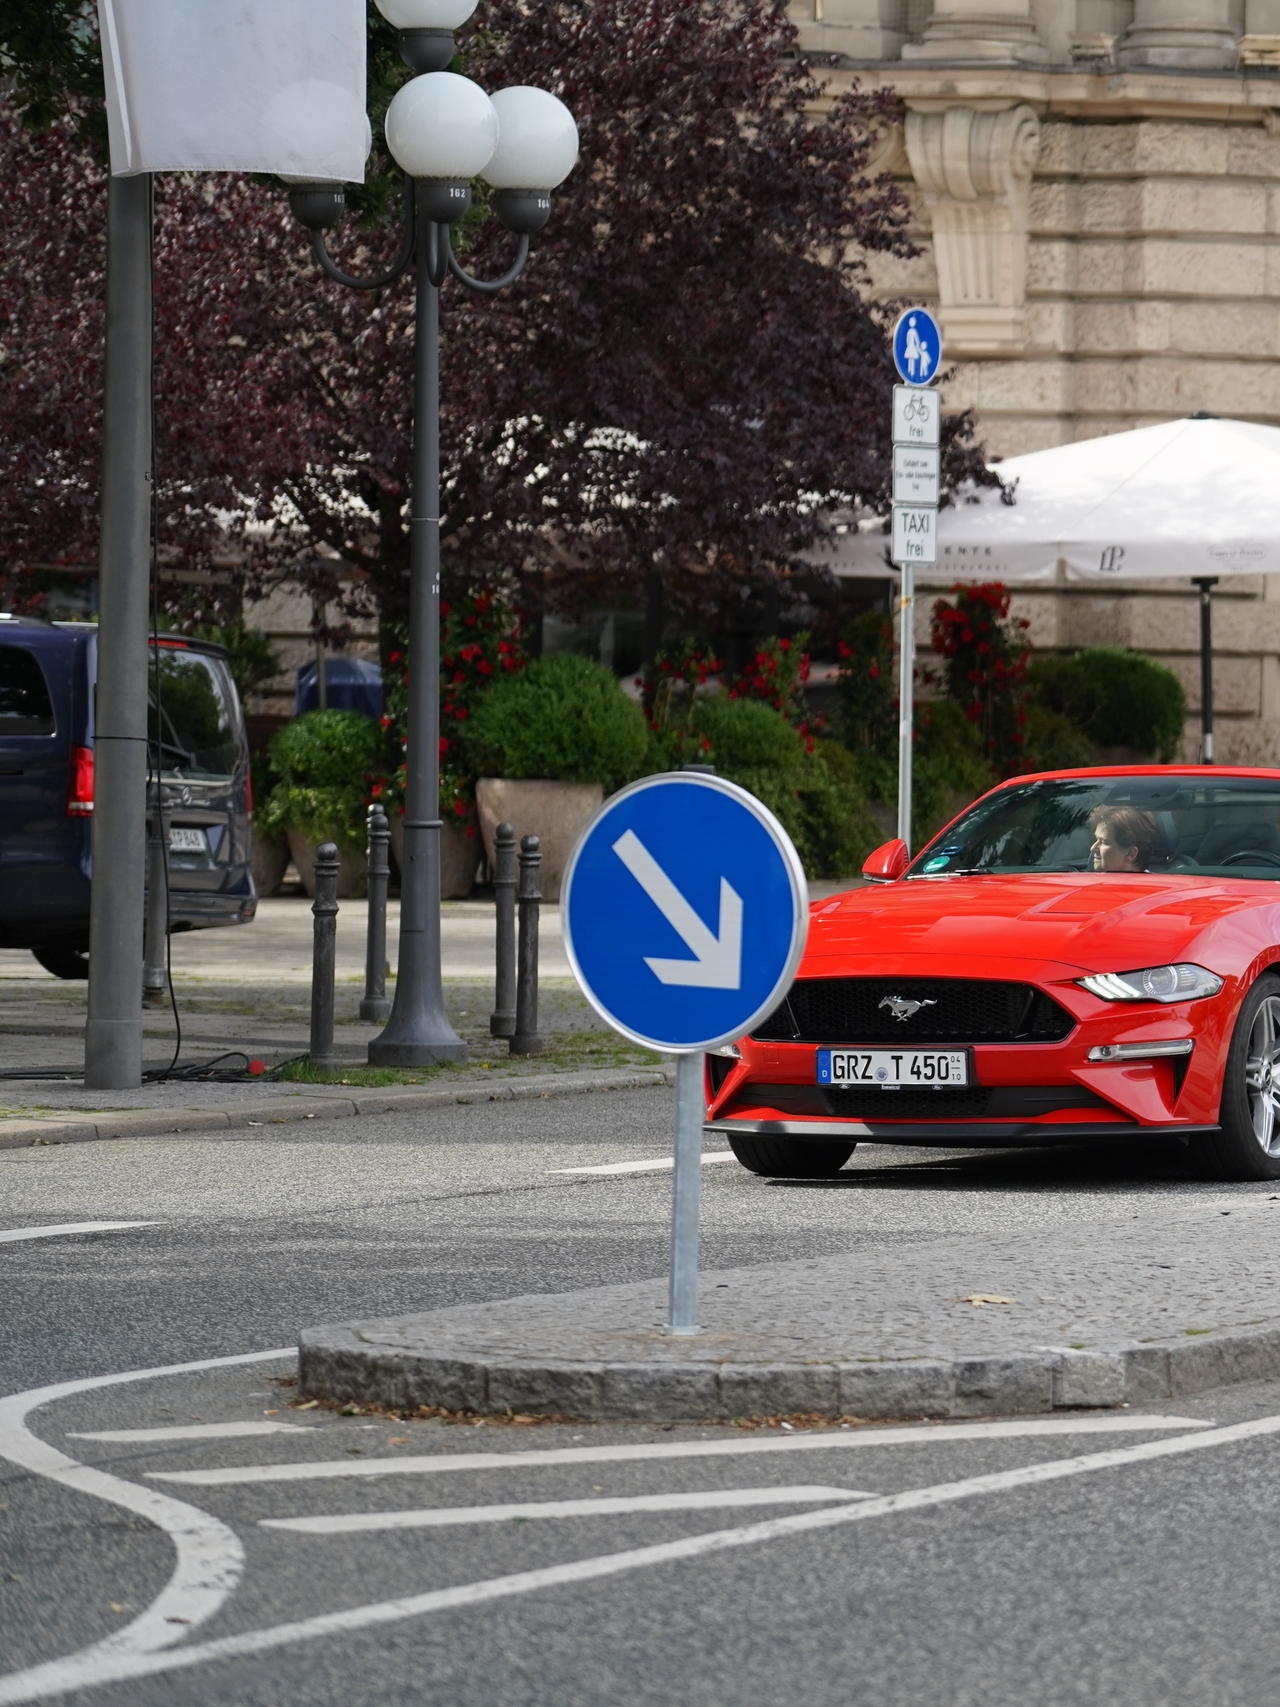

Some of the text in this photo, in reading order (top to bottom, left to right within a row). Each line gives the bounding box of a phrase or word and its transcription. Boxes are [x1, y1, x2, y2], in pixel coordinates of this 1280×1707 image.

[449, 187, 466, 198] 162
[909, 424, 924, 437] frei
[901, 512, 930, 534] TAXI
[906, 539, 924, 557] frei
[950, 1056, 961, 1064] 04
[821, 1054, 950, 1081] D GRZ T 450
[951, 1073, 961, 1081] 10
